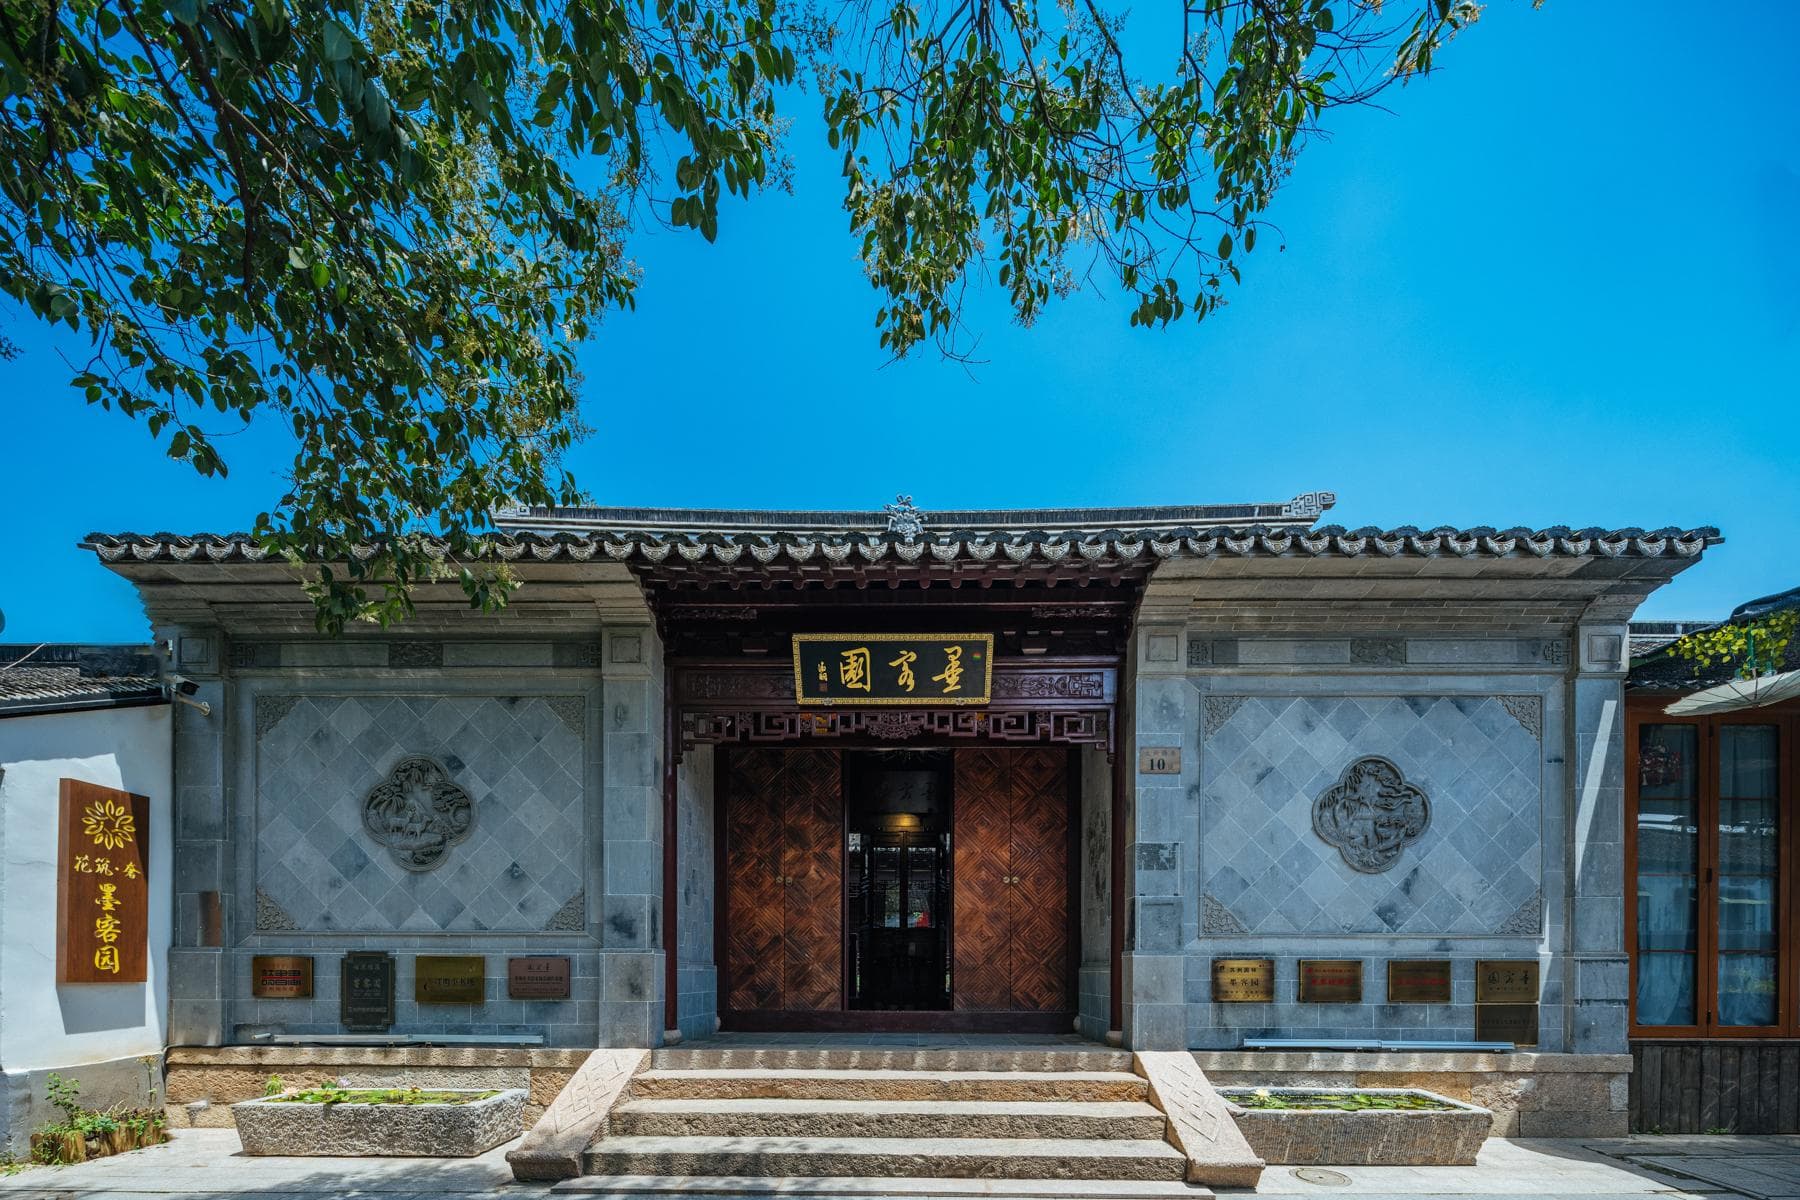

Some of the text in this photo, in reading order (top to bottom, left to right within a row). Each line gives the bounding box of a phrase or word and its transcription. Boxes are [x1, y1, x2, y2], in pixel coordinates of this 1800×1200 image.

[1150, 758, 1166, 770] 10
[94, 883, 122, 974] 墨客园
